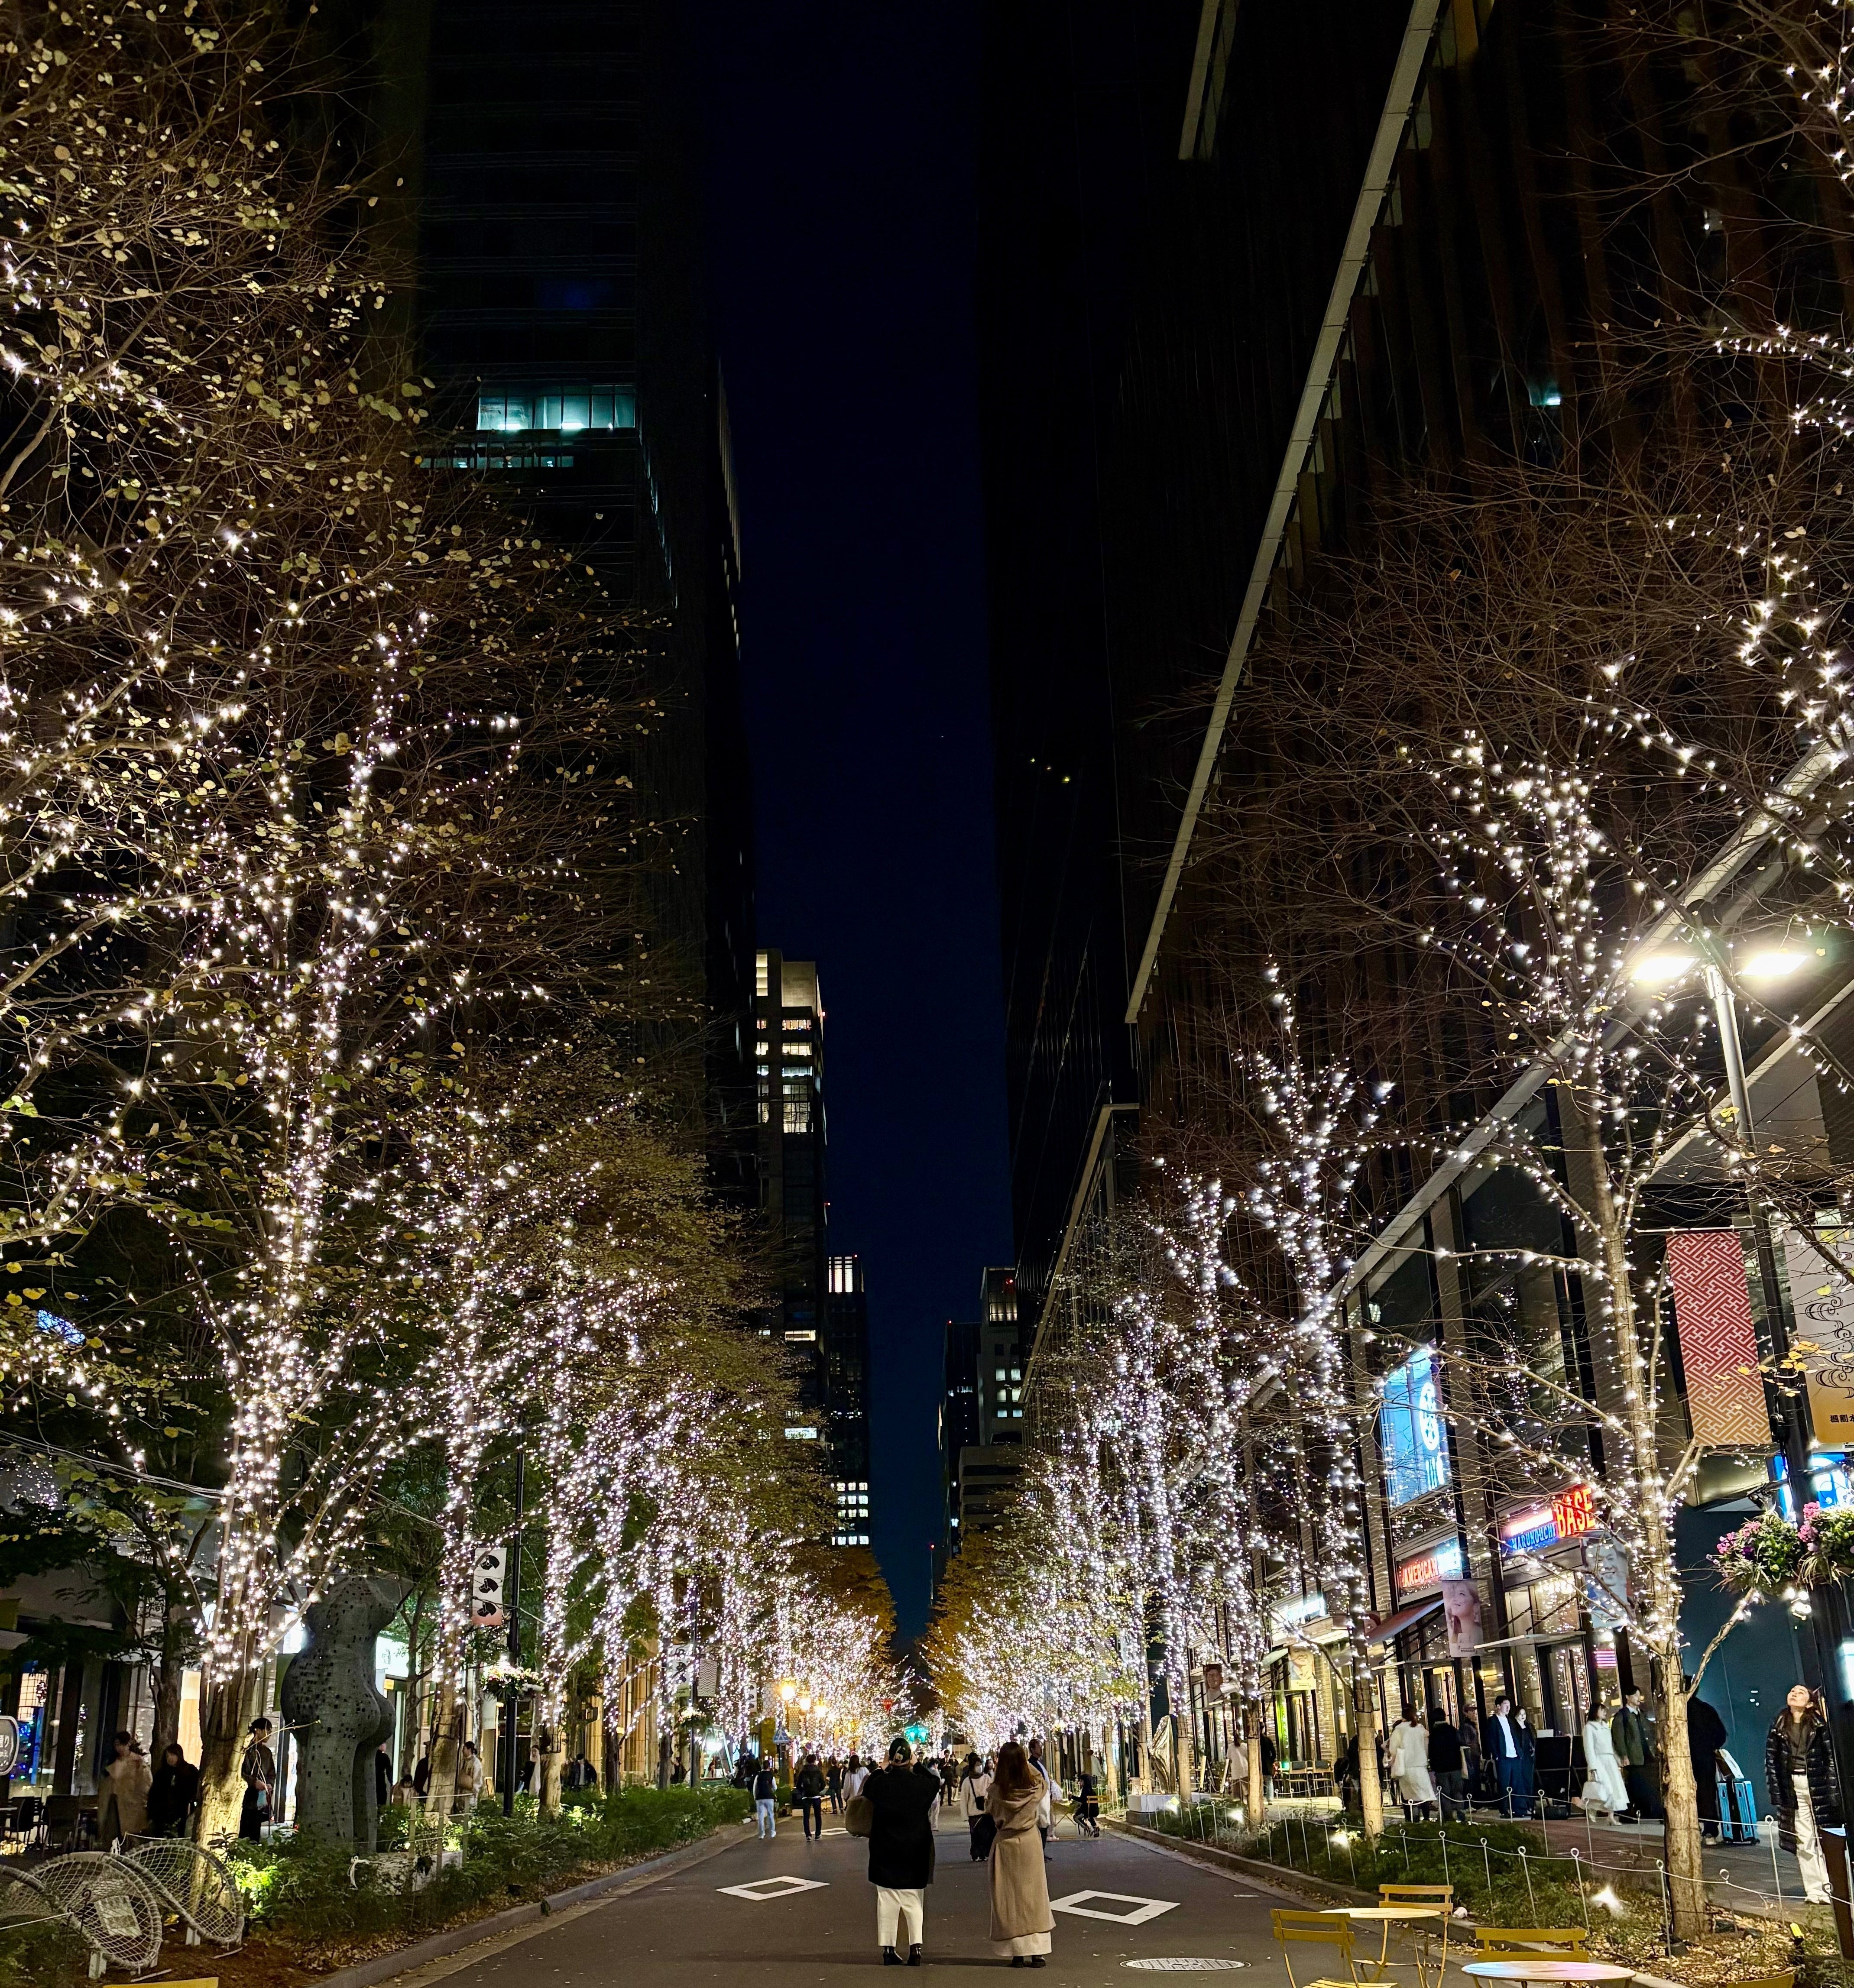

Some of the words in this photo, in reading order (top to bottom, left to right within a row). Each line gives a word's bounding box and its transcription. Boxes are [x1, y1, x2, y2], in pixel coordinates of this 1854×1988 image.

[1555, 1488, 1596, 1537] BASE
[1511, 1522, 1556, 1549] MARUNOUCHI
[1403, 1557, 1439, 1587] AMERICAN
